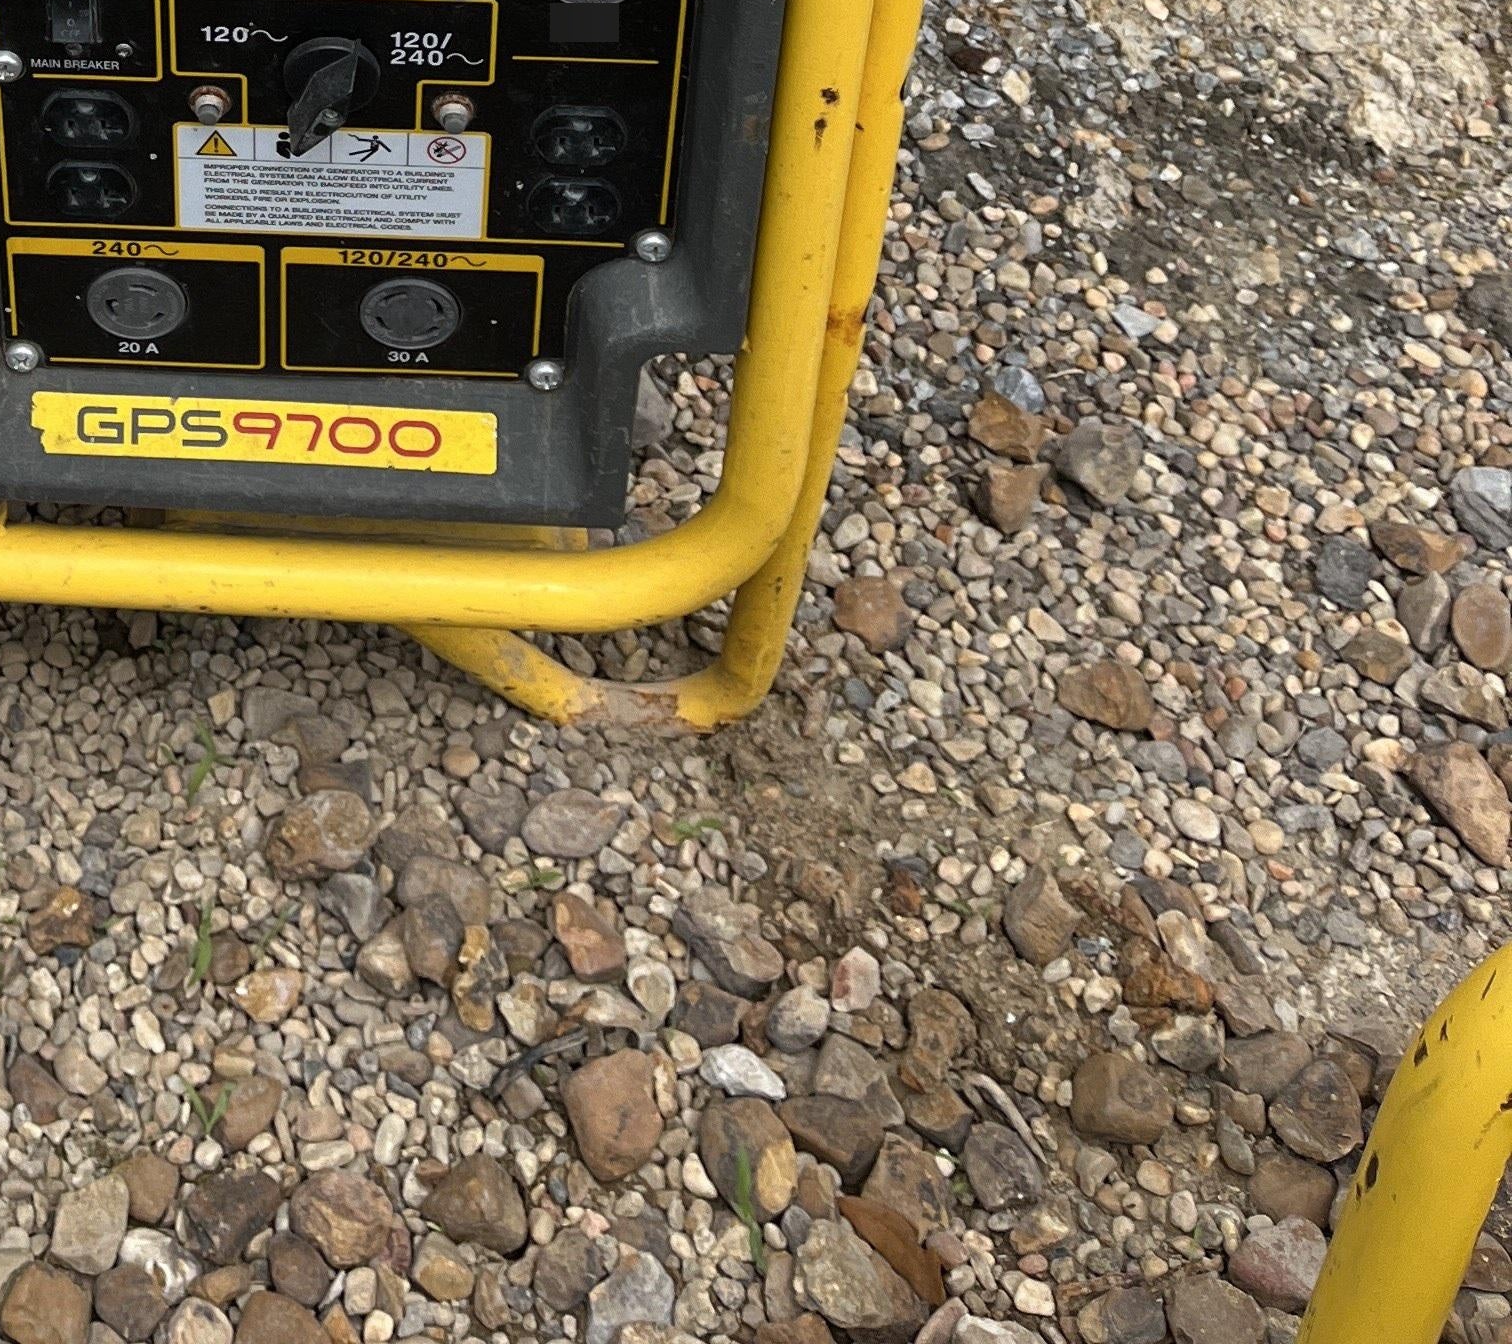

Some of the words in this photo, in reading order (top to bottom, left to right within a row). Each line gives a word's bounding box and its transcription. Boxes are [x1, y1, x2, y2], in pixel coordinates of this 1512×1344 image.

[390, 31, 452, 50] 120/
[30, 58, 61, 69] MAIN
[63, 59, 120, 71] BREAKER
[118, 341, 141, 353] 20
[145, 342, 160, 354] A
[388, 351, 411, 362] 30
[415, 352, 430, 363] A
[76, 405, 442, 458] GPS9700
